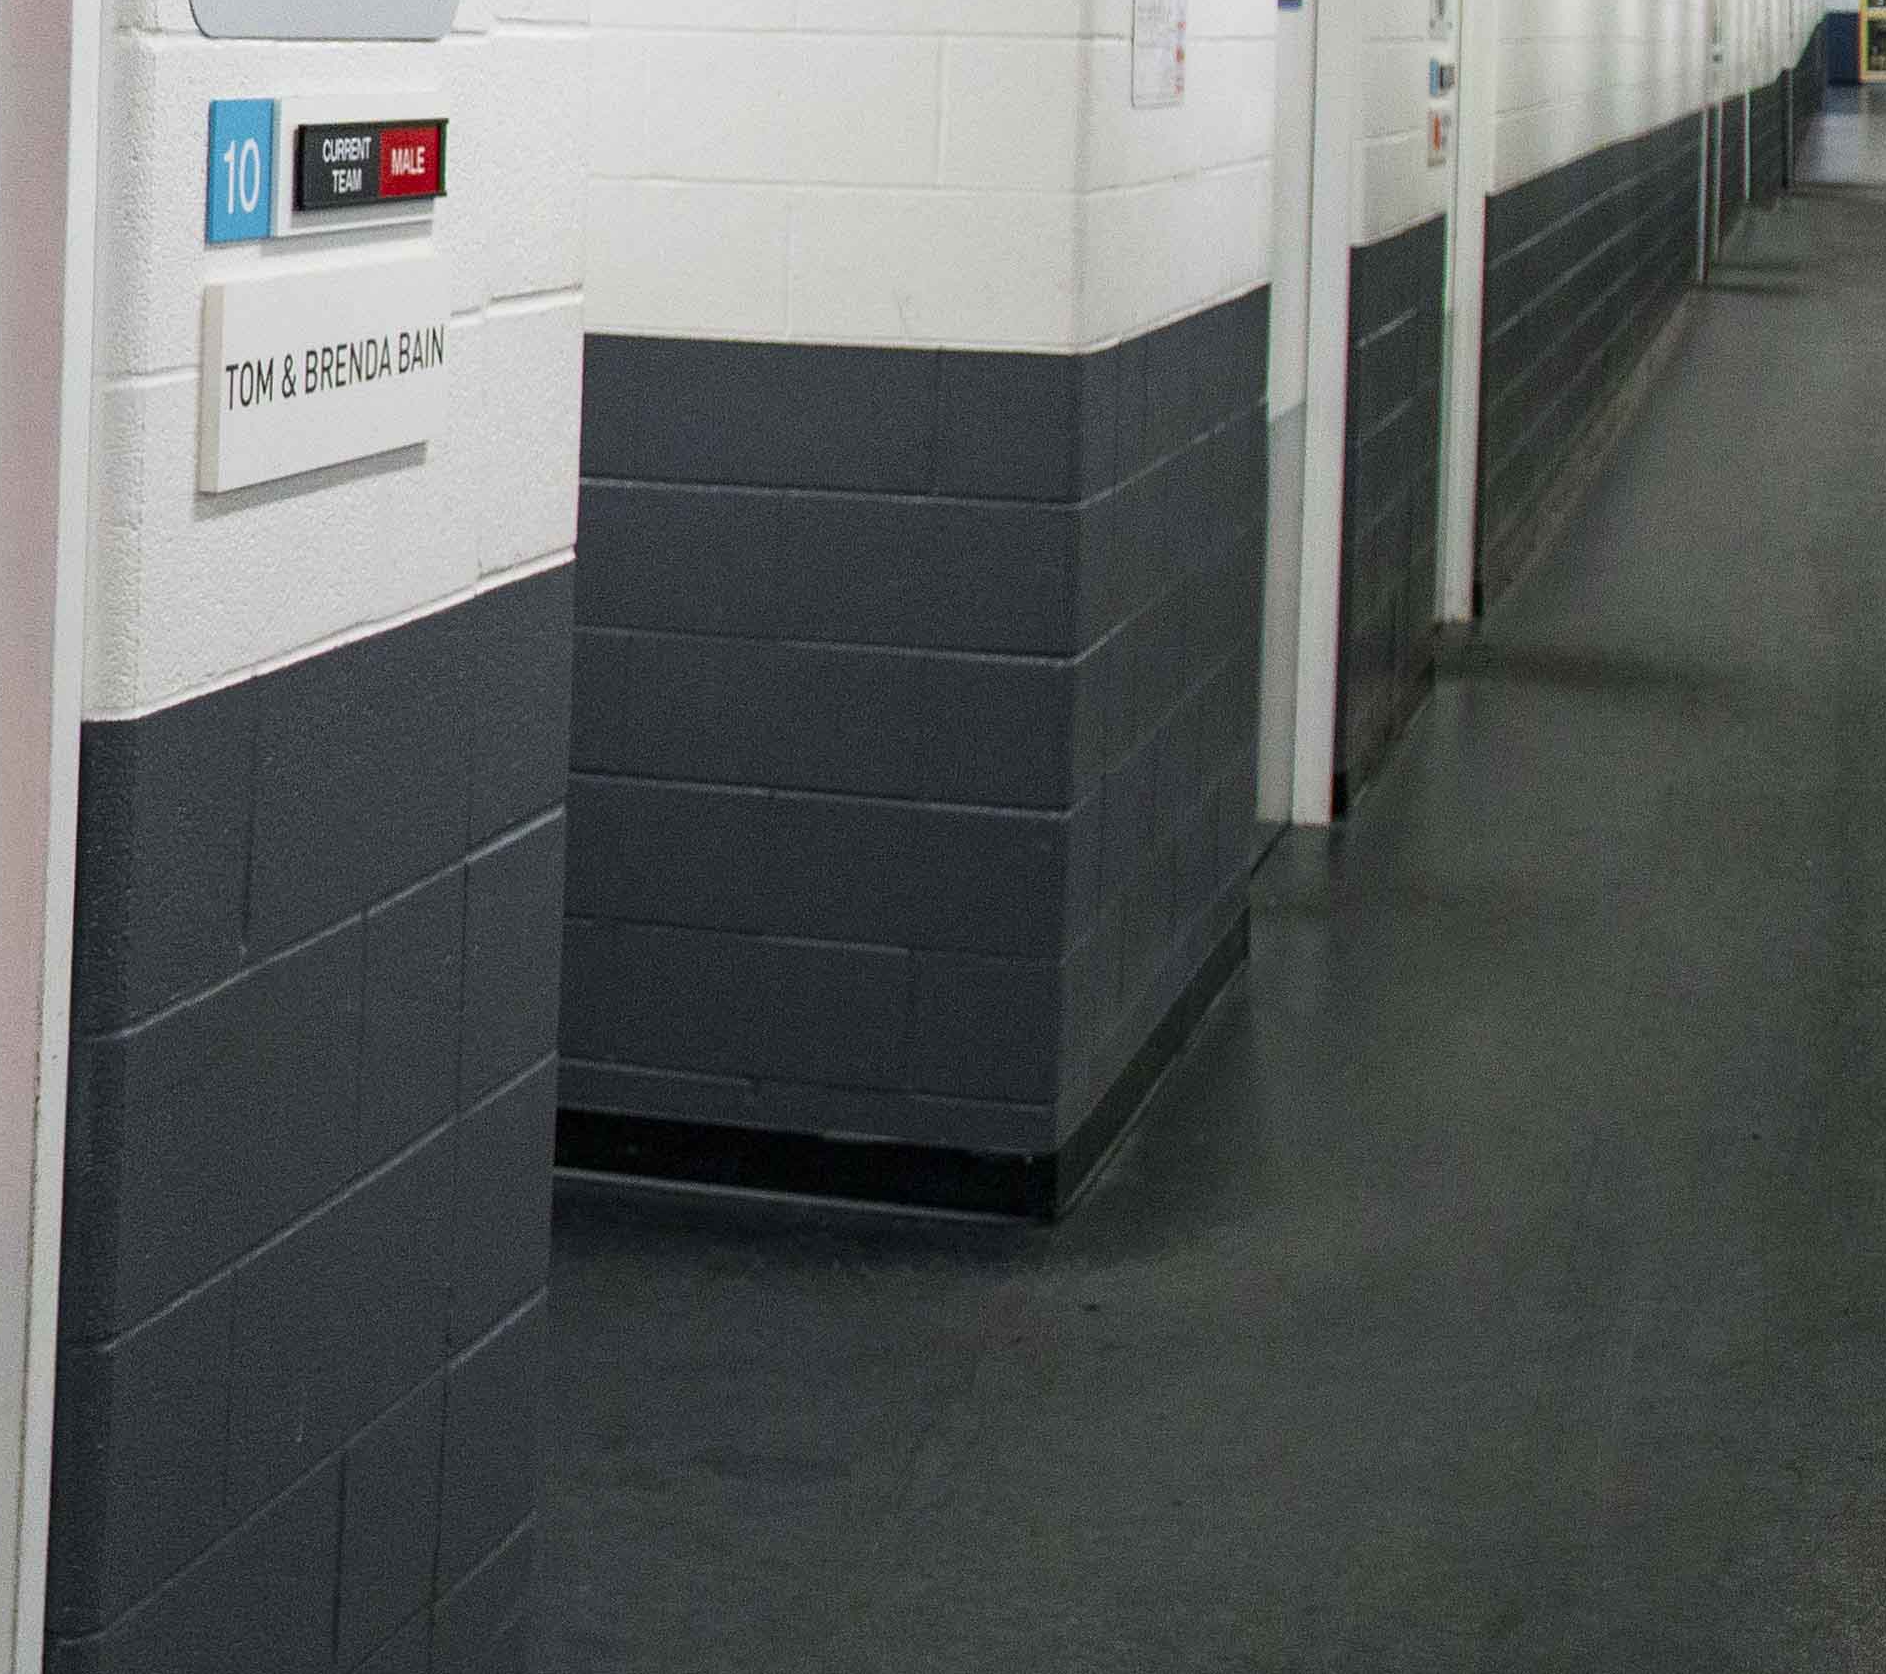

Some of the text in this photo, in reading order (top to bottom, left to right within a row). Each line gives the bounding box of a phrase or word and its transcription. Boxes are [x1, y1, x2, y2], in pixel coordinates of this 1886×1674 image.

[322, 136, 372, 163] CURRENT
[391, 146, 426, 176] MALE
[224, 137, 261, 215] 10
[332, 168, 363, 194] TEAM
[225, 323, 445, 411] TOM & BRENDA BAIN
